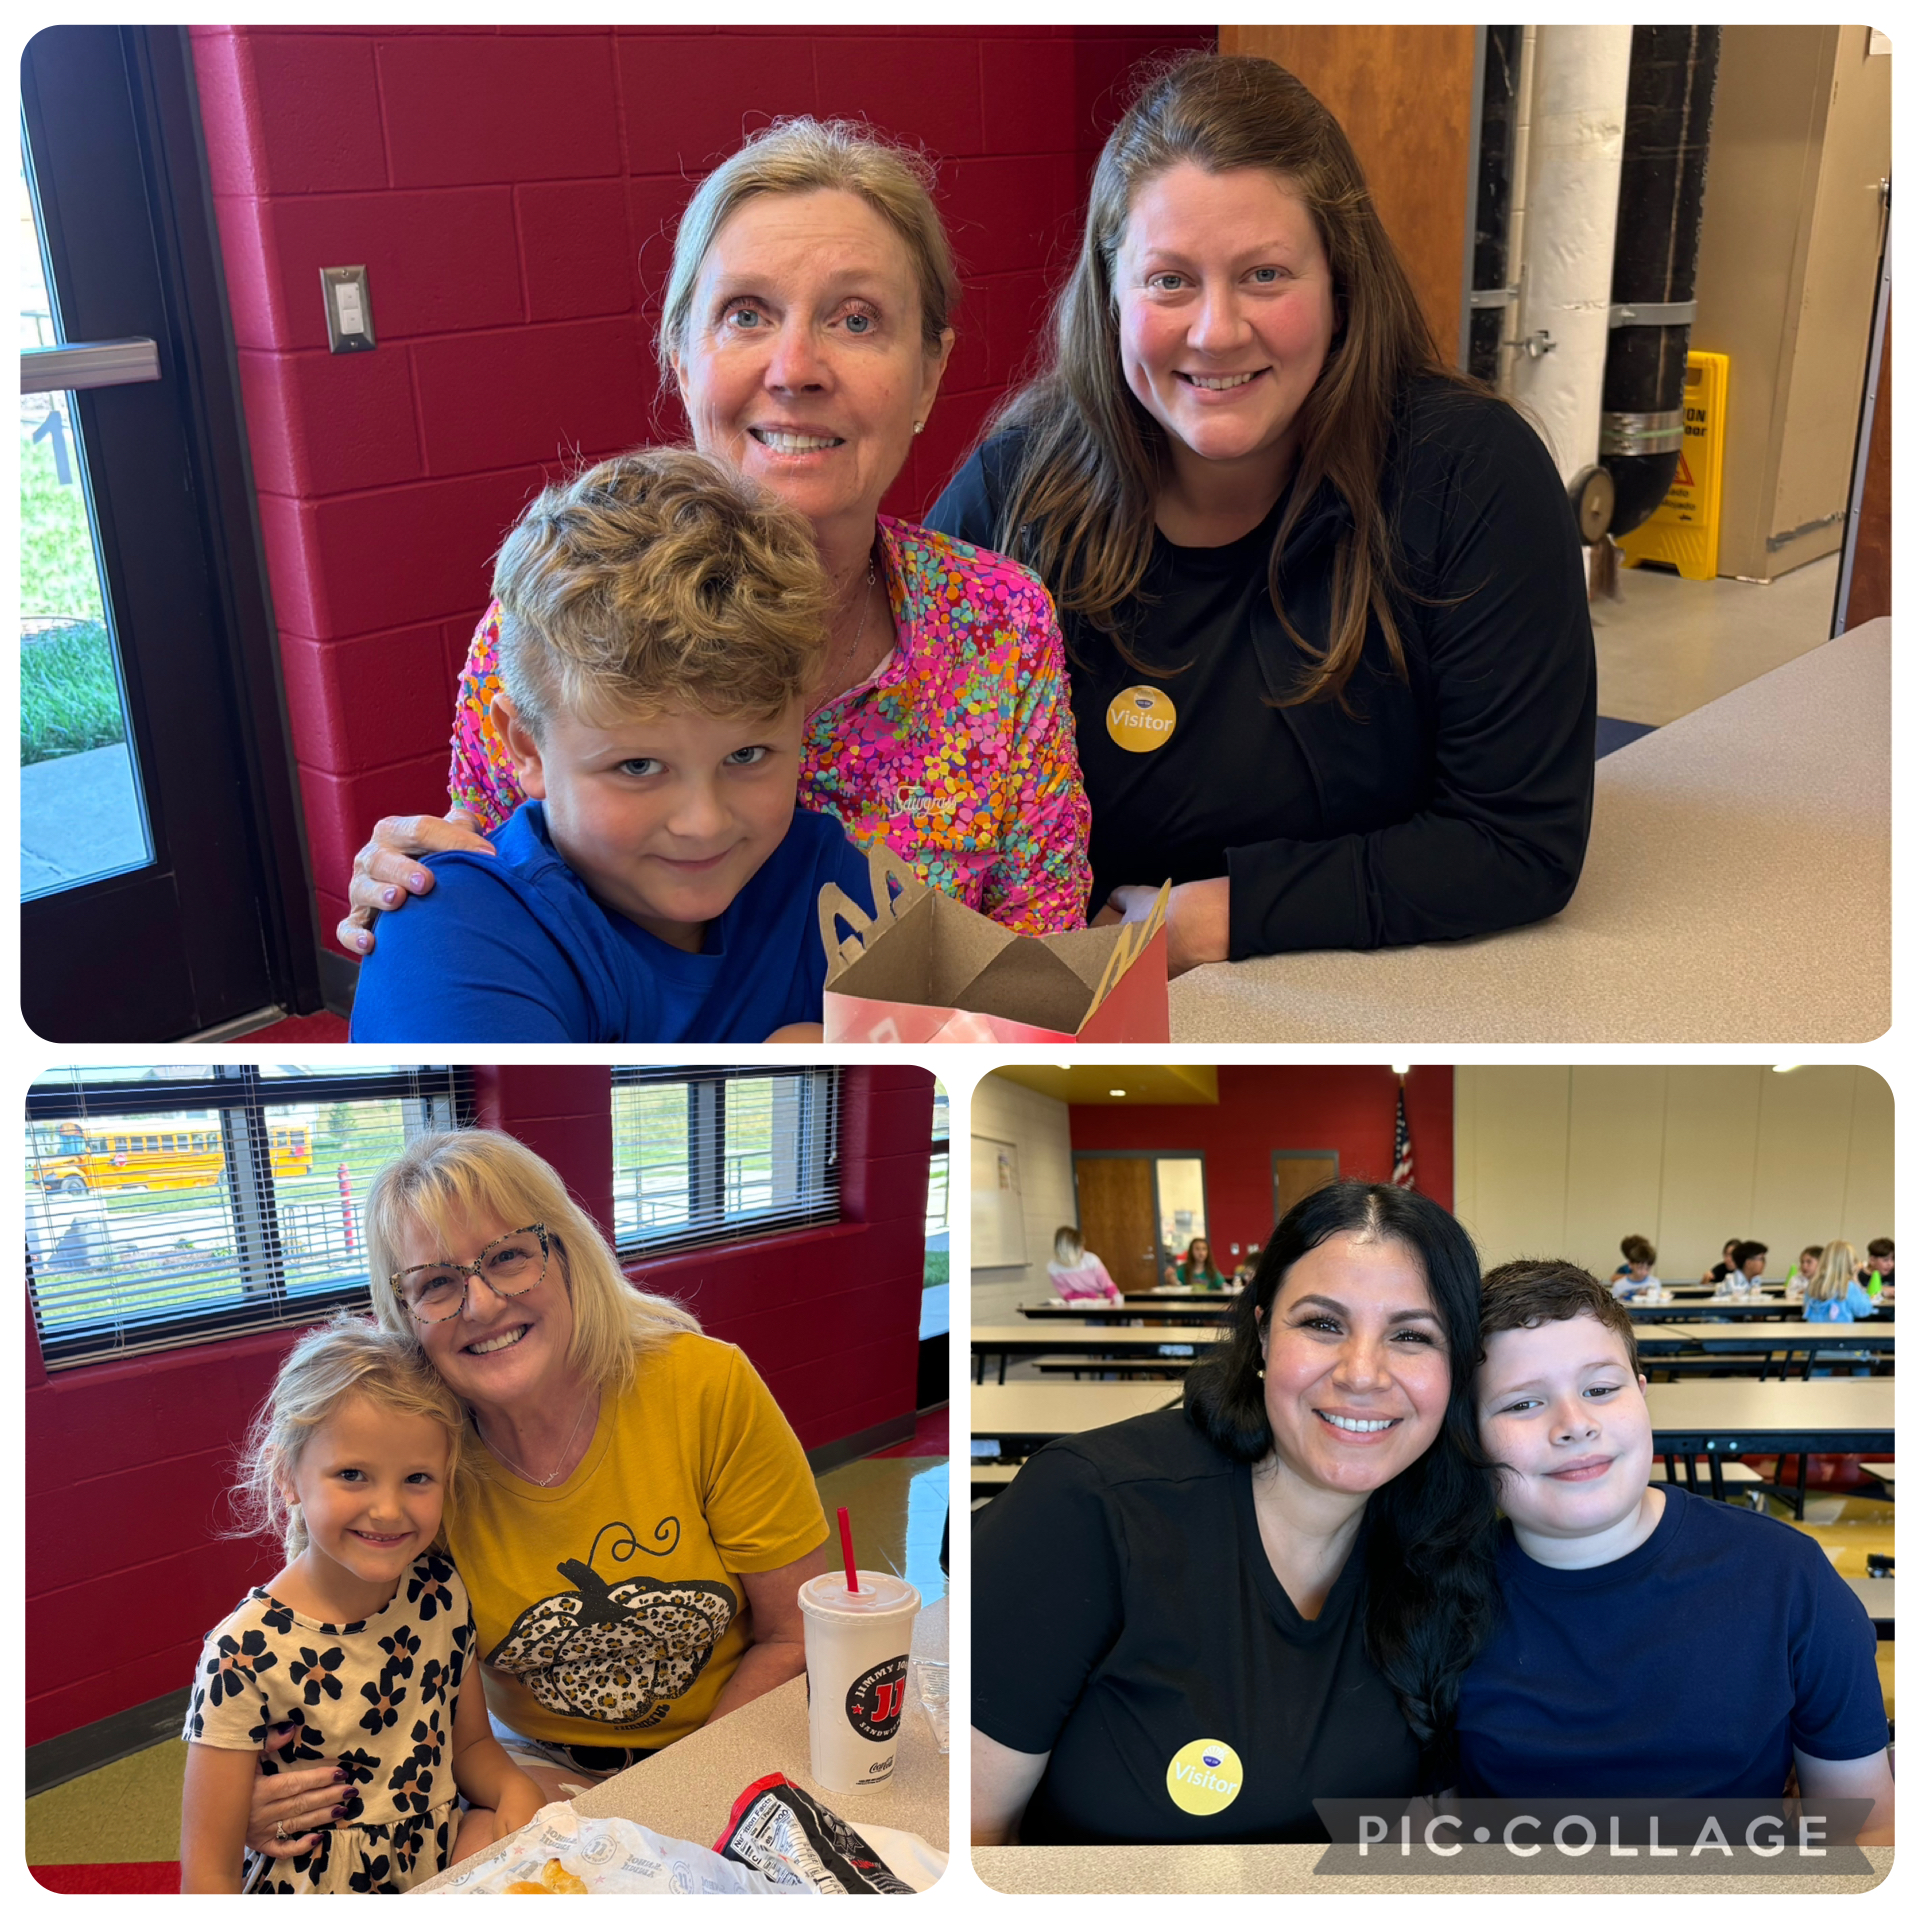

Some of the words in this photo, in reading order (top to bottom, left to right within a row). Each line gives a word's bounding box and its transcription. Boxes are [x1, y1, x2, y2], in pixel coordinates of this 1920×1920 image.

[1683, 408, 1706, 422] ON
[33, 410, 73, 485] 1
[1110, 708, 1173, 732] Visitor
[855, 1664, 894, 1698] JIMMY
[871, 1675, 905, 1723] JJ
[1175, 1761, 1238, 1795] Visitor
[733, 1817, 757, 1849] Nuition
